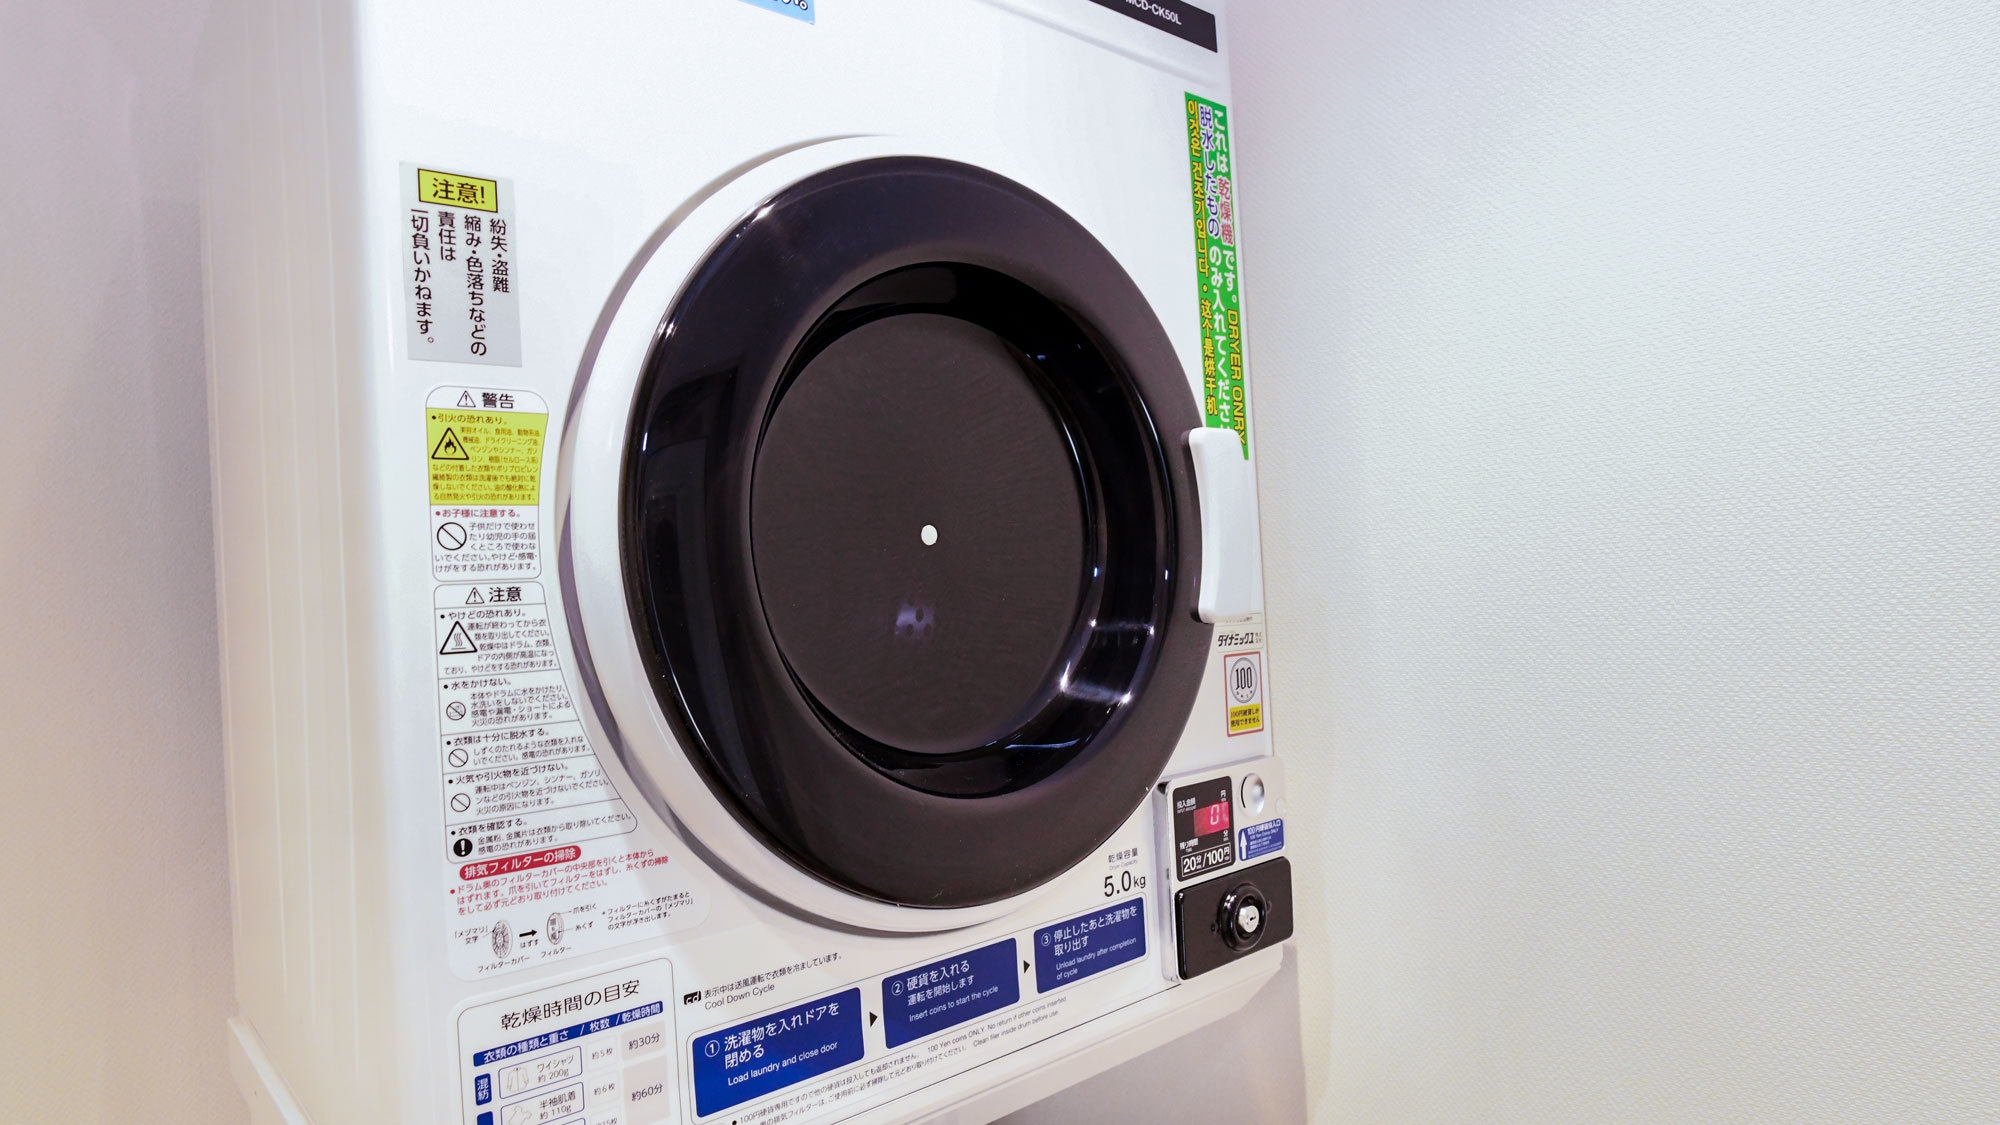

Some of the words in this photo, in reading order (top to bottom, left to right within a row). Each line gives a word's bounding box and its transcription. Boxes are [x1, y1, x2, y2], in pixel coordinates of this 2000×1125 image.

[432, 177, 485, 204] 注意!
[438, 211, 456, 262] 責任は
[490, 218, 510, 294] 紛失・盗難
[411, 208, 434, 344] 一切負いかねます。
[464, 214, 487, 356] 縮み・色落ちなどの
[1227, 309, 1242, 381] DRYER
[482, 392, 514, 409] 警告
[442, 509, 520, 518] お子様に注意する。
[469, 522, 535, 530] 子供だけで使わせ
[469, 532, 536, 541] たり幼児の手の届
[470, 542, 536, 551] くところで使わな
[435, 562, 537, 573] けがをする恐れがあります。
[489, 586, 522, 602] 注意
[448, 609, 526, 621] やけどの恐れあり。
[467, 619, 547, 631] 運転が終わってから衣
[474, 629, 549, 641] 類を取り出してください。
[477, 650, 554, 661] ドアの内側が高温になっ
[450, 678, 512, 690] 水をかけない。
[1235, 666, 1253, 690] 100
[472, 713, 553, 728] 火災の恐れがあります。
[453, 728, 549, 747] 衣類は十分に脱水する。
[456, 763, 569, 785] 火気や引火物を近づけない。
[476, 798, 555, 815] 火災の原因になります。
[458, 818, 528, 837] 衣類を確認する。
[478, 836, 559, 855] 感電の恐れがあります。
[464, 847, 576, 878] 排気フィルターの掃除
[1053, 906, 1138, 943] 停止したあと洗濯物を
[540, 946, 572, 959] フィルター
[1054, 936, 1089, 957] 取り出す
[1055, 958, 1076, 971] Unload
[1076, 952, 1096, 963] laundry
[1096, 947, 1108, 956] after
[1109, 937, 1137, 952] completion
[477, 955, 530, 973] フィルターカバー
[1056, 972, 1062, 980] of
[1063, 968, 1078, 978] cycle
[704, 995, 725, 1010] Cool
[727, 988, 750, 1004] Down
[752, 983, 775, 997] Cycle
[907, 975, 975, 1006] 運転を開始します
[501, 979, 640, 1031] 乾燥時間の目安
[909, 1010, 928, 1022] Insert
[929, 1004, 947, 1015] coins
[947, 1001, 955, 1009] to
[956, 996, 971, 1006] start
[971, 992, 981, 1000] the
[982, 985, 999, 997] cycle
[927, 1044, 939, 1053] 100
[939, 1038, 951, 1048] Yen
[951, 1034, 967, 1045] coins
[987, 1023, 996, 1031] No
[996, 1017, 1012, 1028] return
[1017, 1009, 1031, 1020] other
[1031, 1005, 1045, 1014] coins
[1046, 996, 1067, 1010] inserted
[973, 1036, 989, 1048] Clean
[1001, 1025, 1017, 1036] inside
[1017, 1020, 1031, 1030] drum
[1031, 1014, 1049, 1026] before
[483, 1030, 569, 1064] 衣類の種類と重さ
[589, 1018, 610, 1033] 枚数
[537, 1055, 574, 1073] ワイシャツ
[724, 1046, 765, 1070] 閉める
[728, 1070, 749, 1086] Load
[750, 1060, 780, 1078] laundry
[782, 1054, 797, 1067] and
[798, 1047, 819, 1061] close
[820, 1041, 838, 1054] door
